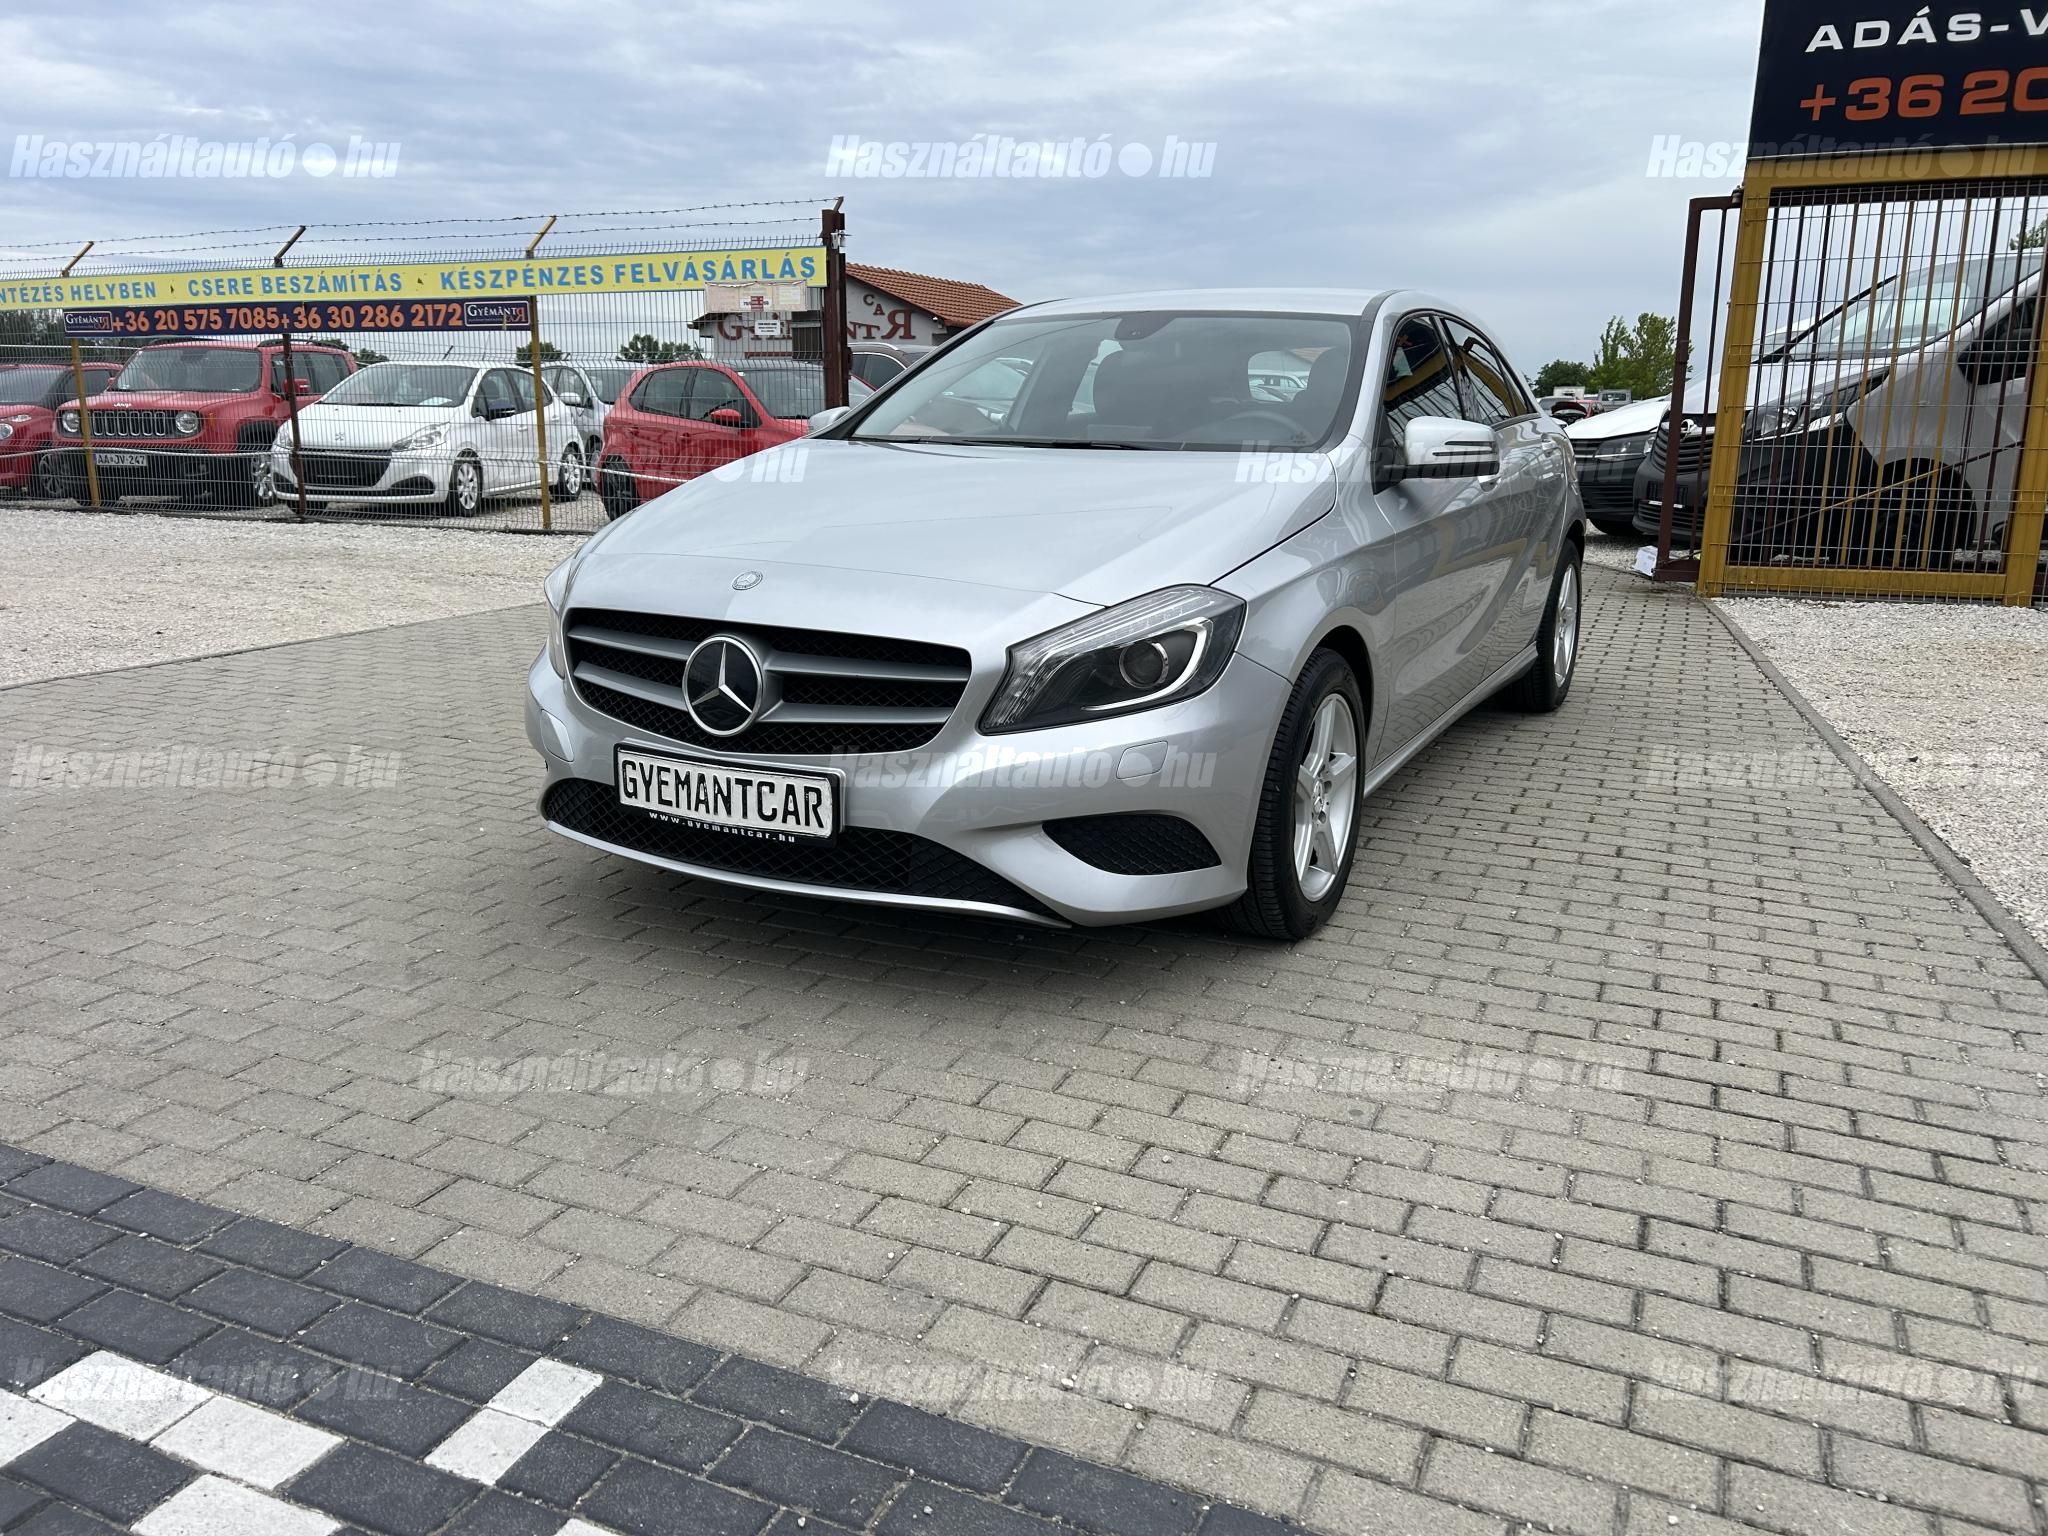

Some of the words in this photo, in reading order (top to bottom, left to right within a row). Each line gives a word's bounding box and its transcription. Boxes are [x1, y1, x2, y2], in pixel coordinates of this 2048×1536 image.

[1800, 74, 1945, 121] +36
[70, 281, 157, 301] HELYBEN
[188, 277, 253, 297] CSERE
[261, 270, 401, 294] BESZÁMÍTÁS
[440, 263, 604, 291] KÉSZPÉNZES
[614, 252, 816, 284] FELVÁSÁRLÁS
[184, 309, 222, 330] 575
[327, 305, 355, 328] 30
[360, 304, 405, 328] 286
[410, 302, 463, 327] 2172
[622, 760, 824, 829] GYEMANTCAR
[649, 812, 796, 843] www.gyemantcar.hu
